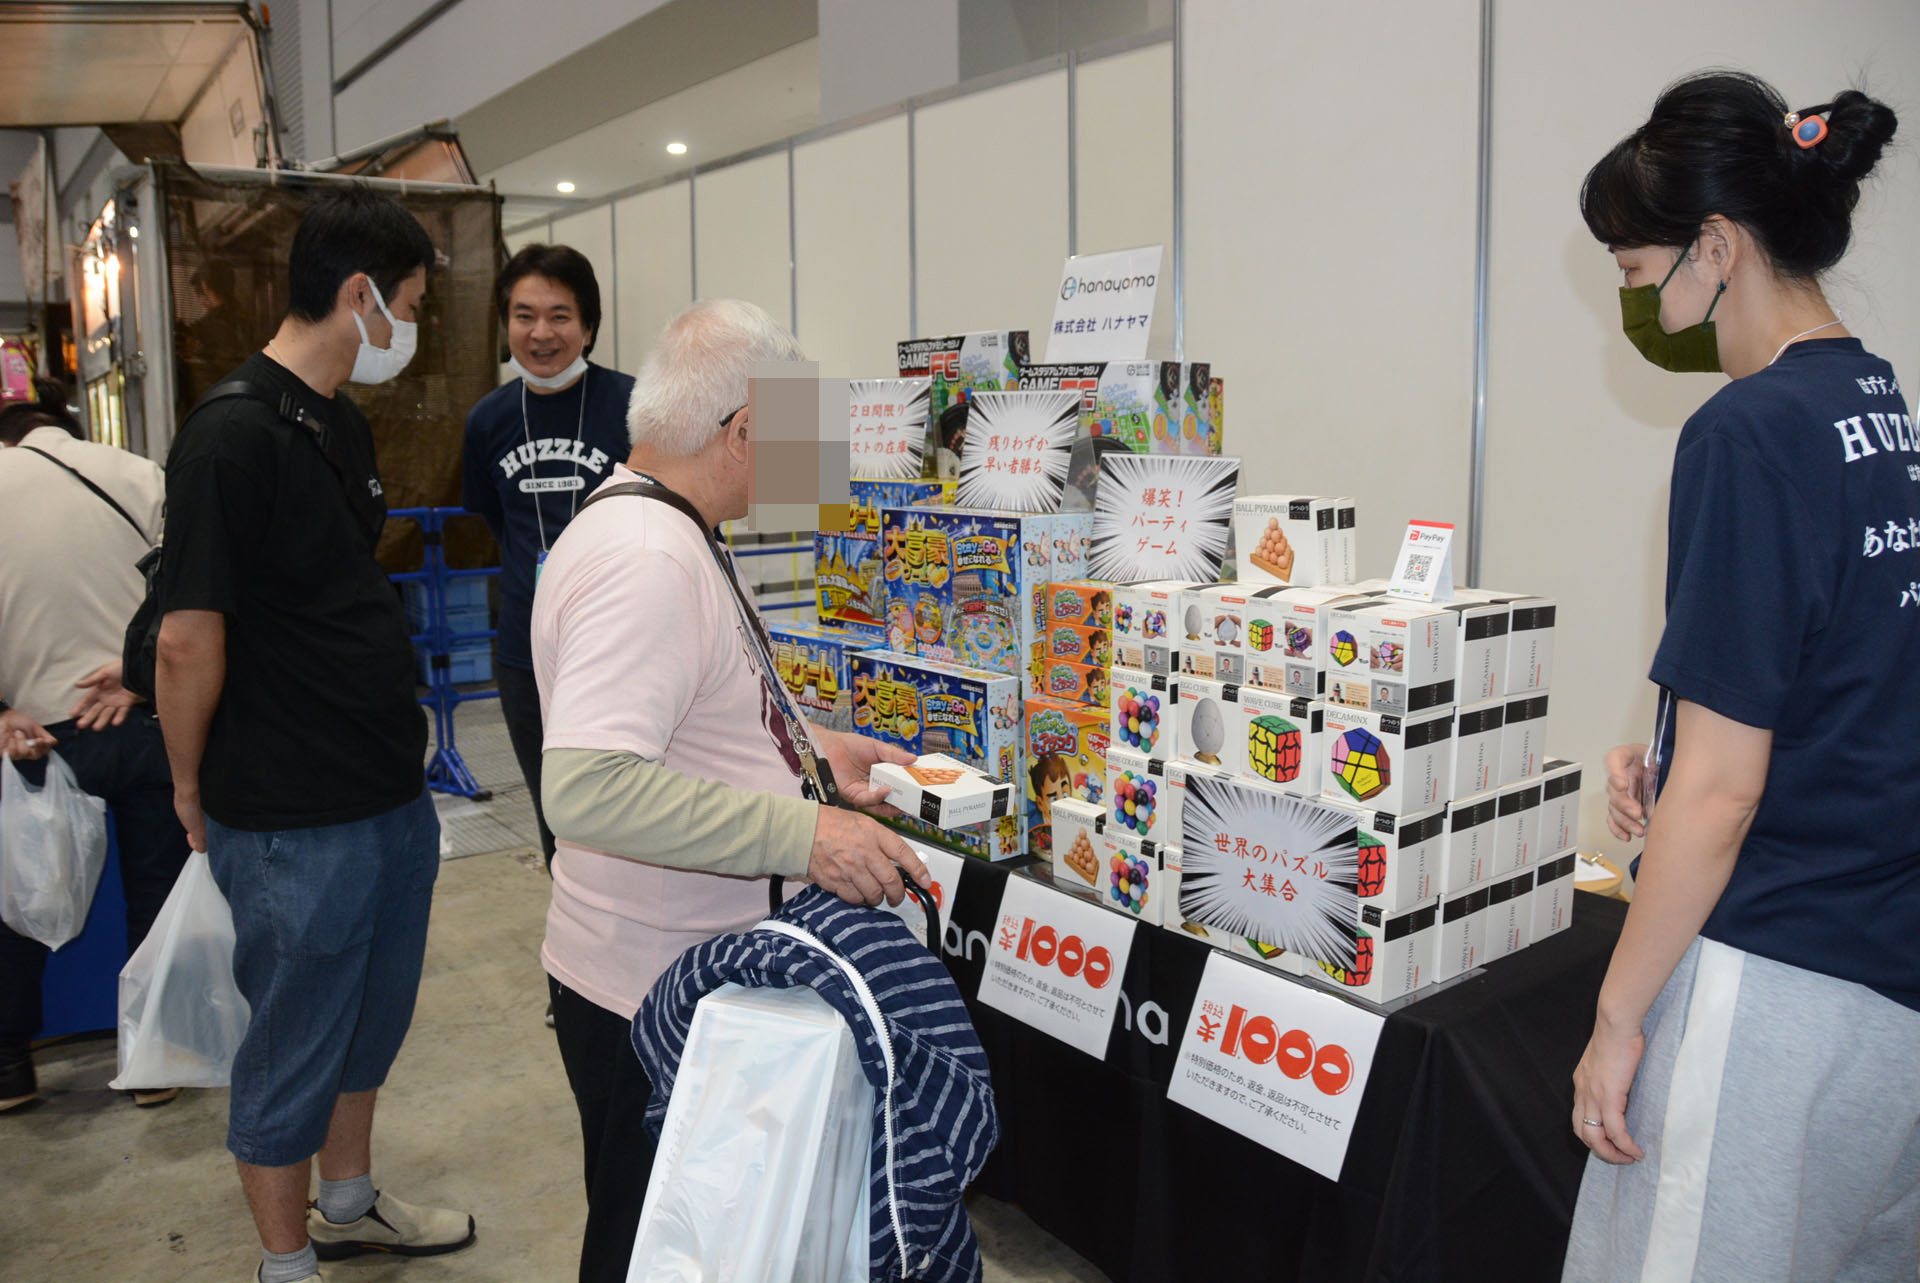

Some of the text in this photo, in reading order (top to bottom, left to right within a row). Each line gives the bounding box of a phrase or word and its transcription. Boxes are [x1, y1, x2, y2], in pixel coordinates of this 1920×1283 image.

[1077, 274, 1156, 294] hanayama
[1054, 314, 1148, 335] 株式会社 ハナヤマ
[899, 353, 929, 369] GAME
[930, 350, 960, 380] FC
[1018, 377, 1059, 391] GAME
[850, 404, 905, 417] 2日間限り
[853, 424, 898, 436] メーカー
[988, 435, 1050, 451] 残りわずか
[498, 438, 609, 479] HUZZLE
[984, 456, 1043, 475] 早い者勝ち
[525, 481, 554, 489] SINCE
[1235, 503, 1288, 515] BALL PYRAMID
[1131, 512, 1187, 533] パーティ
[1136, 536, 1177, 555] ゲーム
[1420, 532, 1446, 543] PayPay
[884, 526, 950, 568] 大富豪
[956, 542, 978, 556] Stay
[1180, 681, 1192, 690] EGG
[854, 672, 919, 718] 大富豪
[1243, 695, 1284, 711] WAVE CUBE
[925, 698, 948, 712] Stay
[1326, 709, 1369, 726] DECAMINX
[1169, 769, 1183, 779] EGG
[948, 802, 986, 815] BALL PYRAMID
[1052, 807, 1067, 820] BALL
[1067, 811, 1095, 828] PYRAMID
[1214, 832, 1330, 880] 世界のパズル
[1241, 867, 1299, 902] 大集合
[1201, 999, 1224, 1019] 税込
[1186, 1069, 1308, 1134] いただきますので、ご了承ください。
